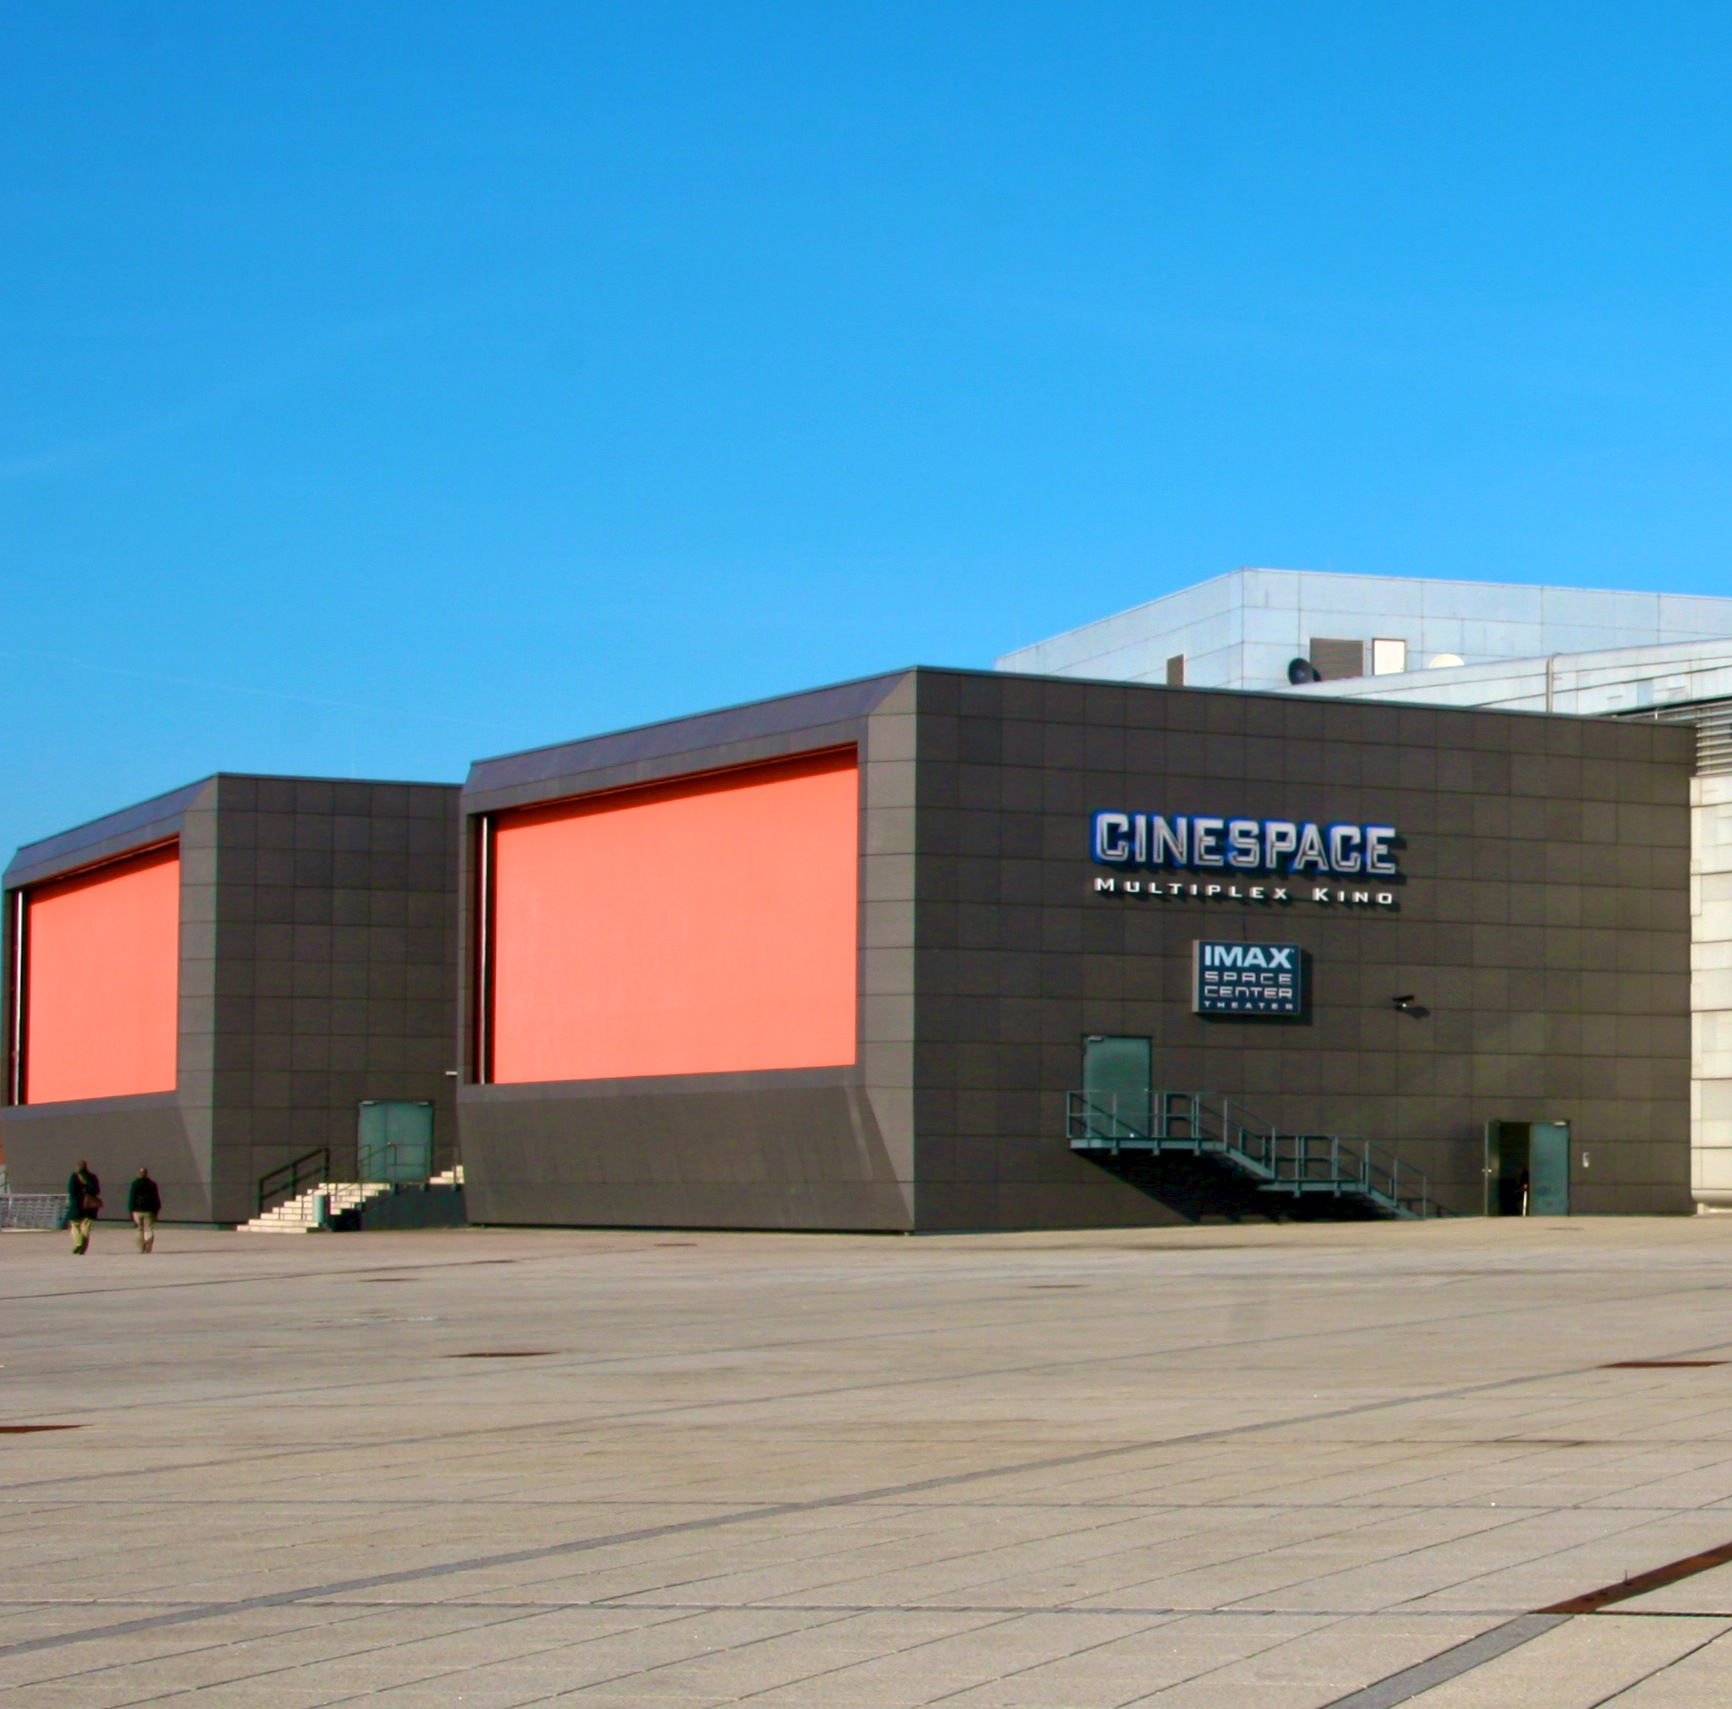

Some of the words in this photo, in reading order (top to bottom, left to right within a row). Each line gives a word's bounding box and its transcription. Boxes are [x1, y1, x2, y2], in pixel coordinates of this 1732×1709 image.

[1093, 811, 1397, 875] CINESPACE
[1094, 877, 1287, 900] MULTIPLEX
[1311, 887, 1393, 905] KINO
[1204, 945, 1292, 969] IMAX
[1204, 971, 1292, 985] SPACE
[1204, 985, 1293, 999] CENTER
[1203, 1001, 1293, 1011] THEATER
